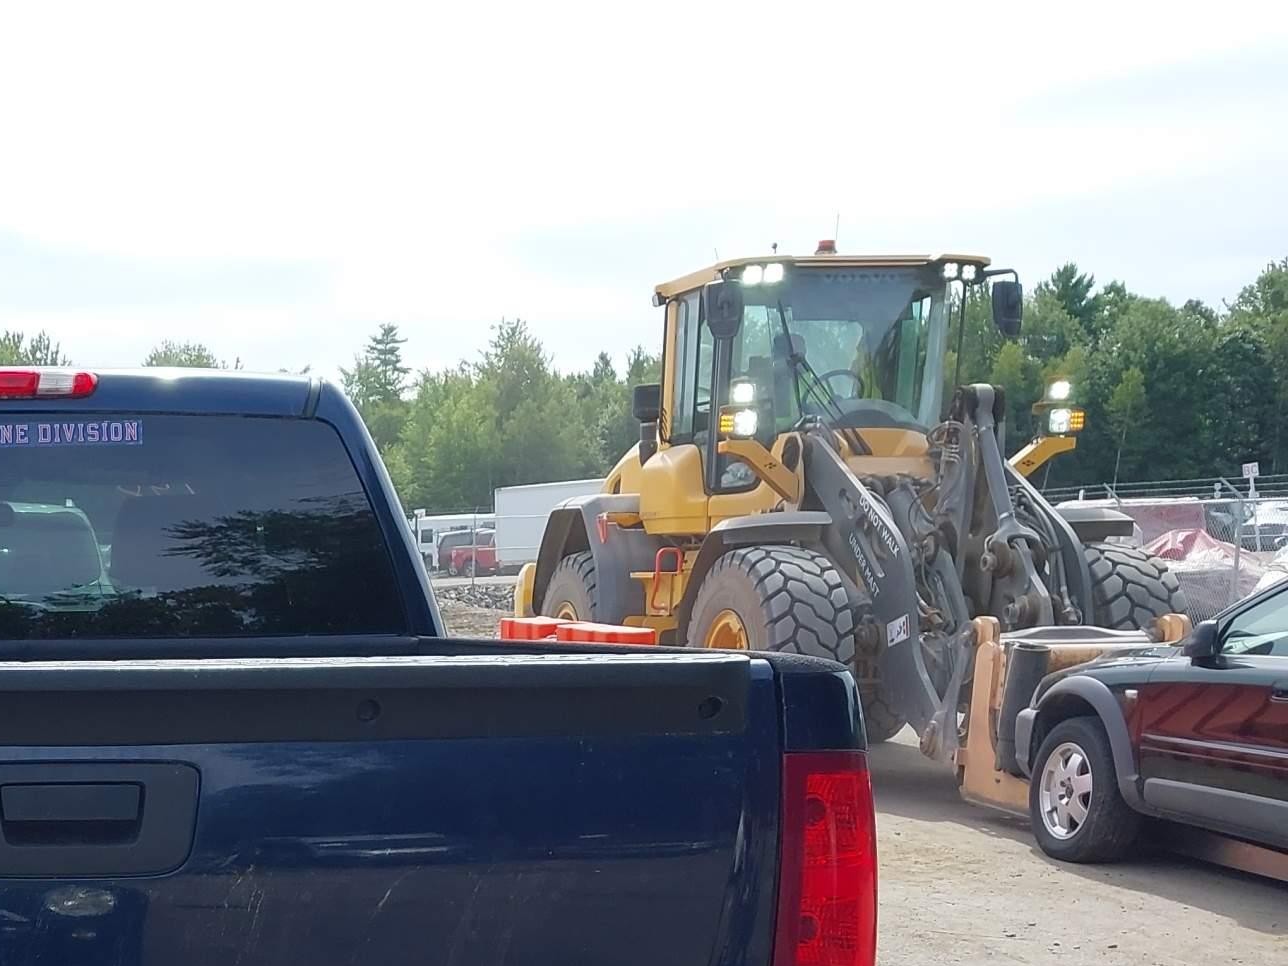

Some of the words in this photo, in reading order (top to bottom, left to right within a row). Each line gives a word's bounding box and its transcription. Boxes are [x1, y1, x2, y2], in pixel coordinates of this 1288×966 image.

[38, 422, 138, 443] DIVISION
[859, 494, 870, 512] DO
[868, 509, 884, 532] NOT
[881, 528, 900, 558] WALK
[849, 532, 867, 570] UNDER
[865, 567, 880, 598] MAST
